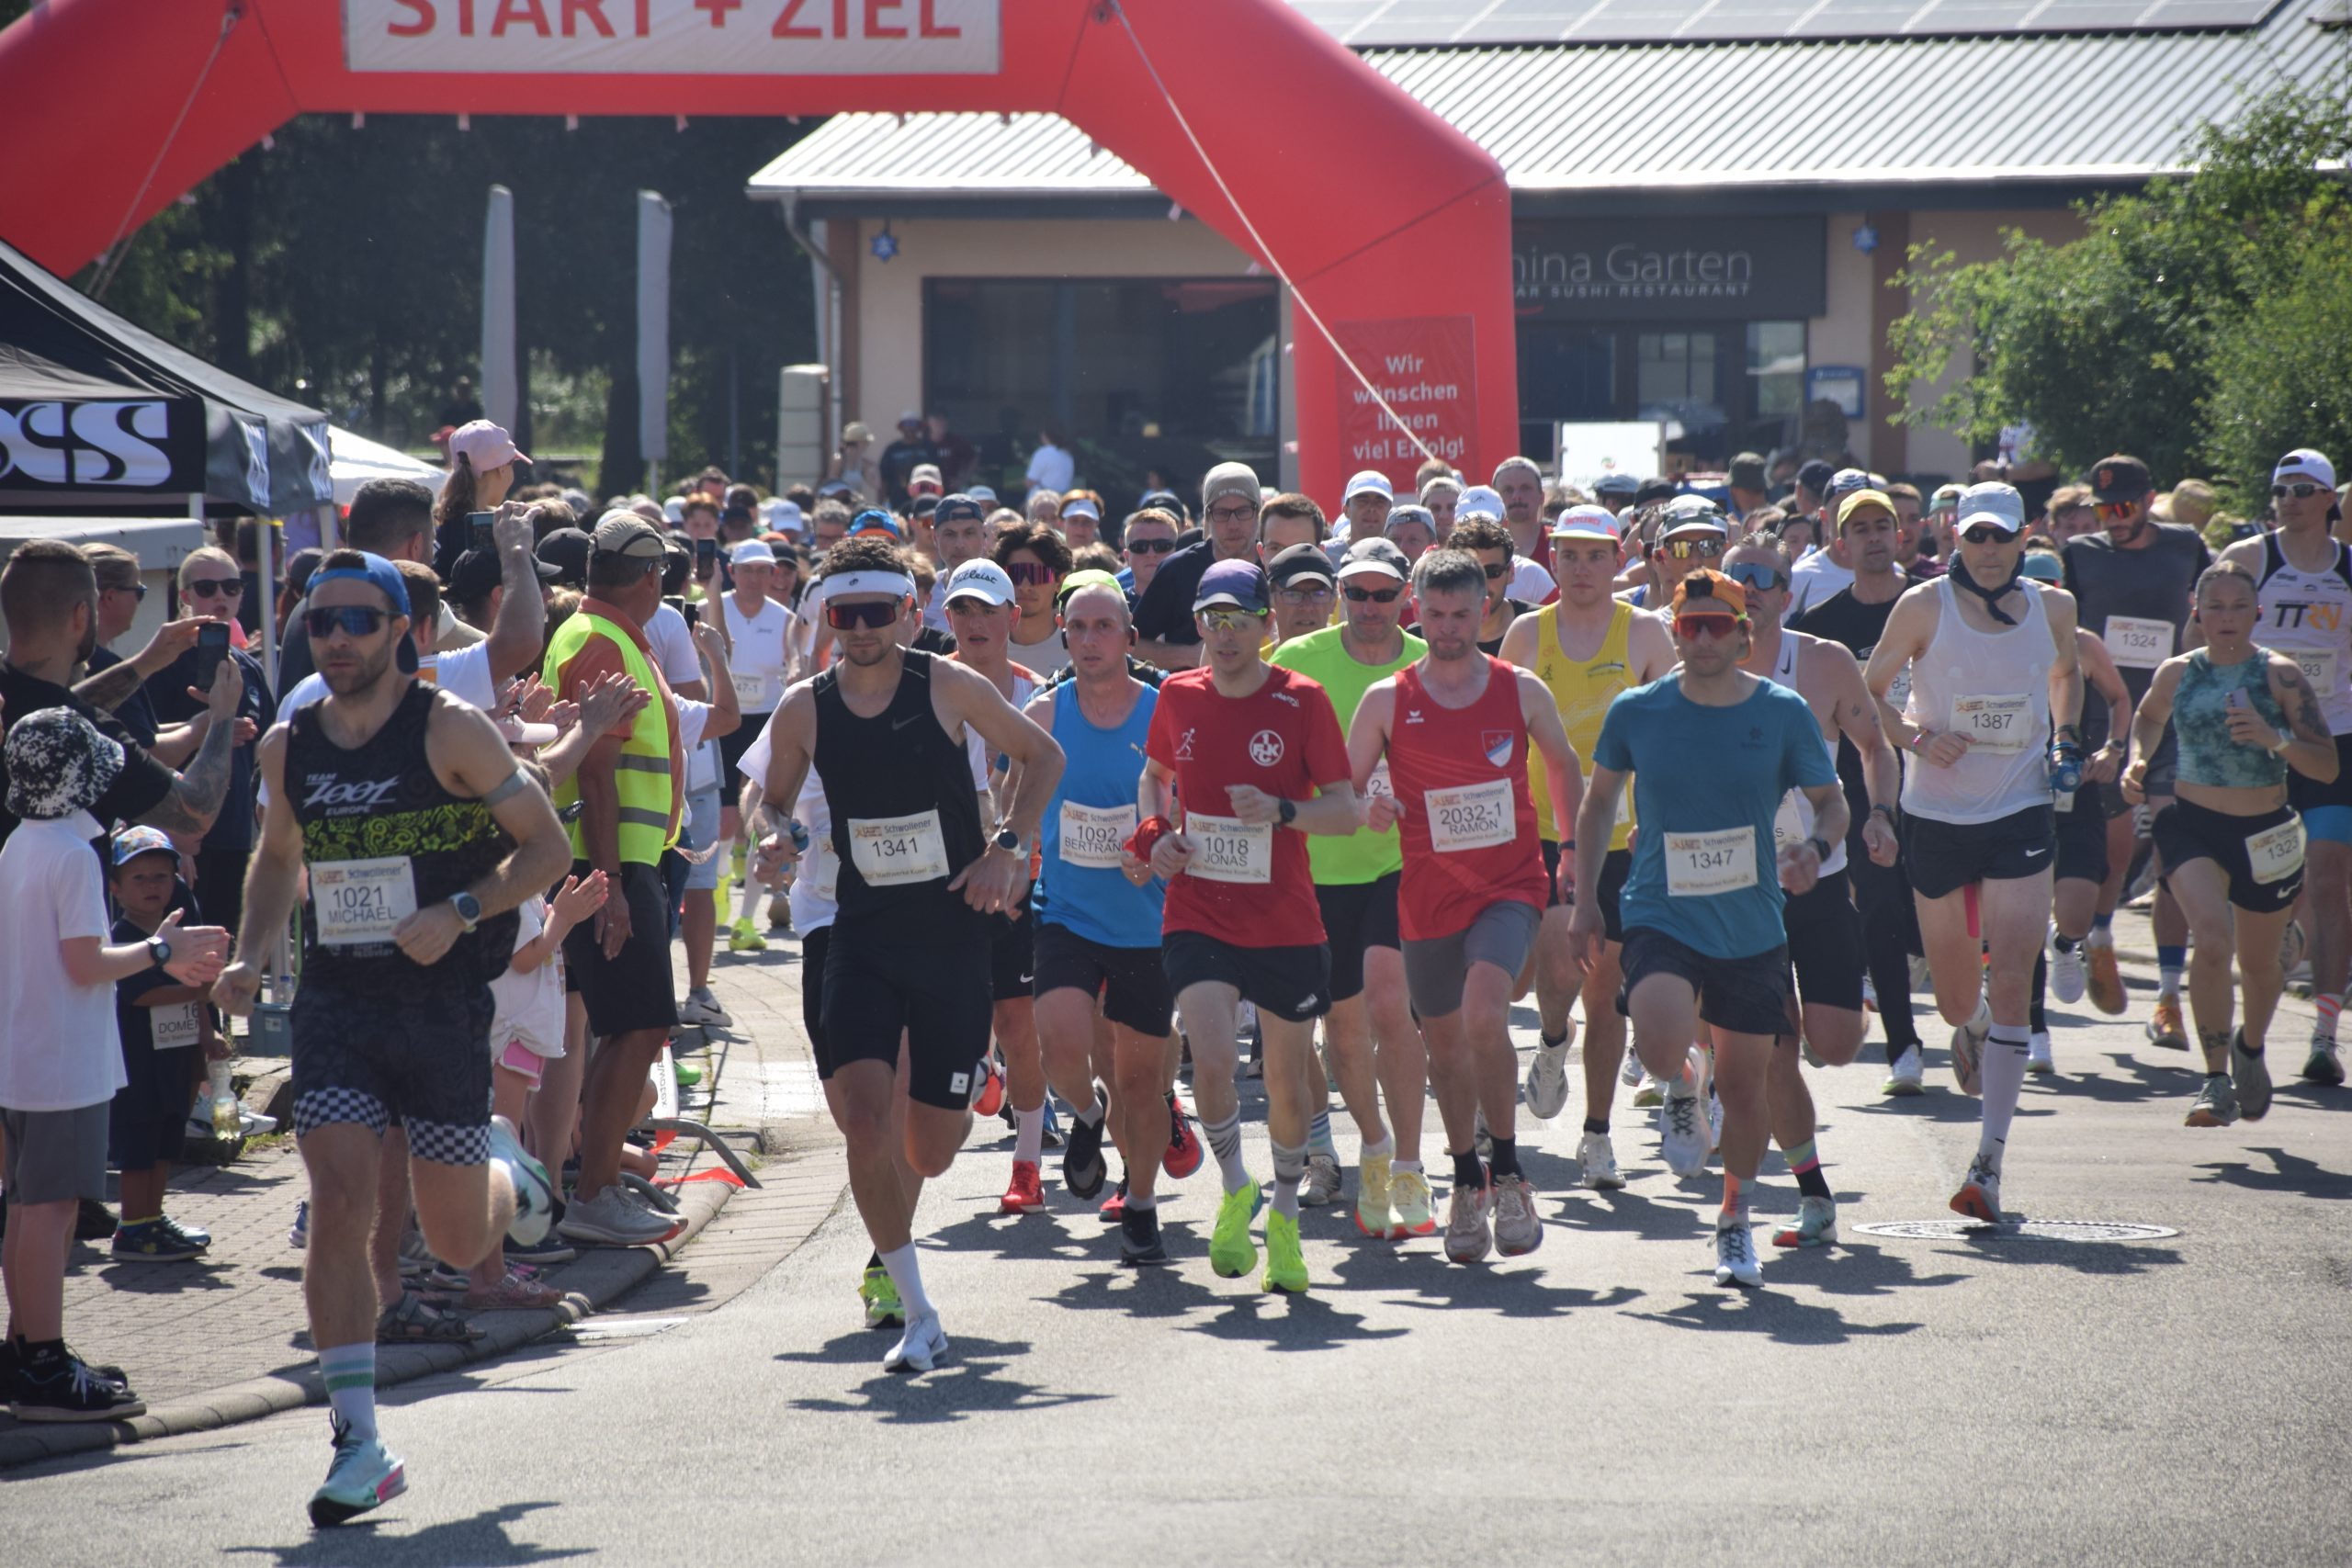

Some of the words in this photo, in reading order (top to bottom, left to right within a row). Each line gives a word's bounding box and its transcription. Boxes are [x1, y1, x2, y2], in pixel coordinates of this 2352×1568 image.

[1607, 243, 1752, 283] Garten
[1551, 287, 1609, 299] SUSHI
[1620, 285, 1749, 298] RESTAURANT
[1385, 353, 1423, 375] Wir
[1353, 439, 1389, 460] viel
[2122, 633, 2157, 649] 1324
[1972, 713, 2013, 729] 1387
[306, 773, 337, 782] TEAM
[325, 805, 371, 816] EUROPE
[1440, 800, 1501, 825] 2032-1
[884, 819, 931, 834] Schwollener
[1077, 825, 1117, 843] 1092
[1449, 818, 1498, 835] RAMON
[872, 837, 919, 858] 1341
[1204, 836, 1250, 855] 1018
[1204, 852, 1249, 867] JONAS
[1689, 849, 1734, 869] 1347
[333, 886, 383, 908] 1021
[328, 907, 397, 923] MICHAEL
